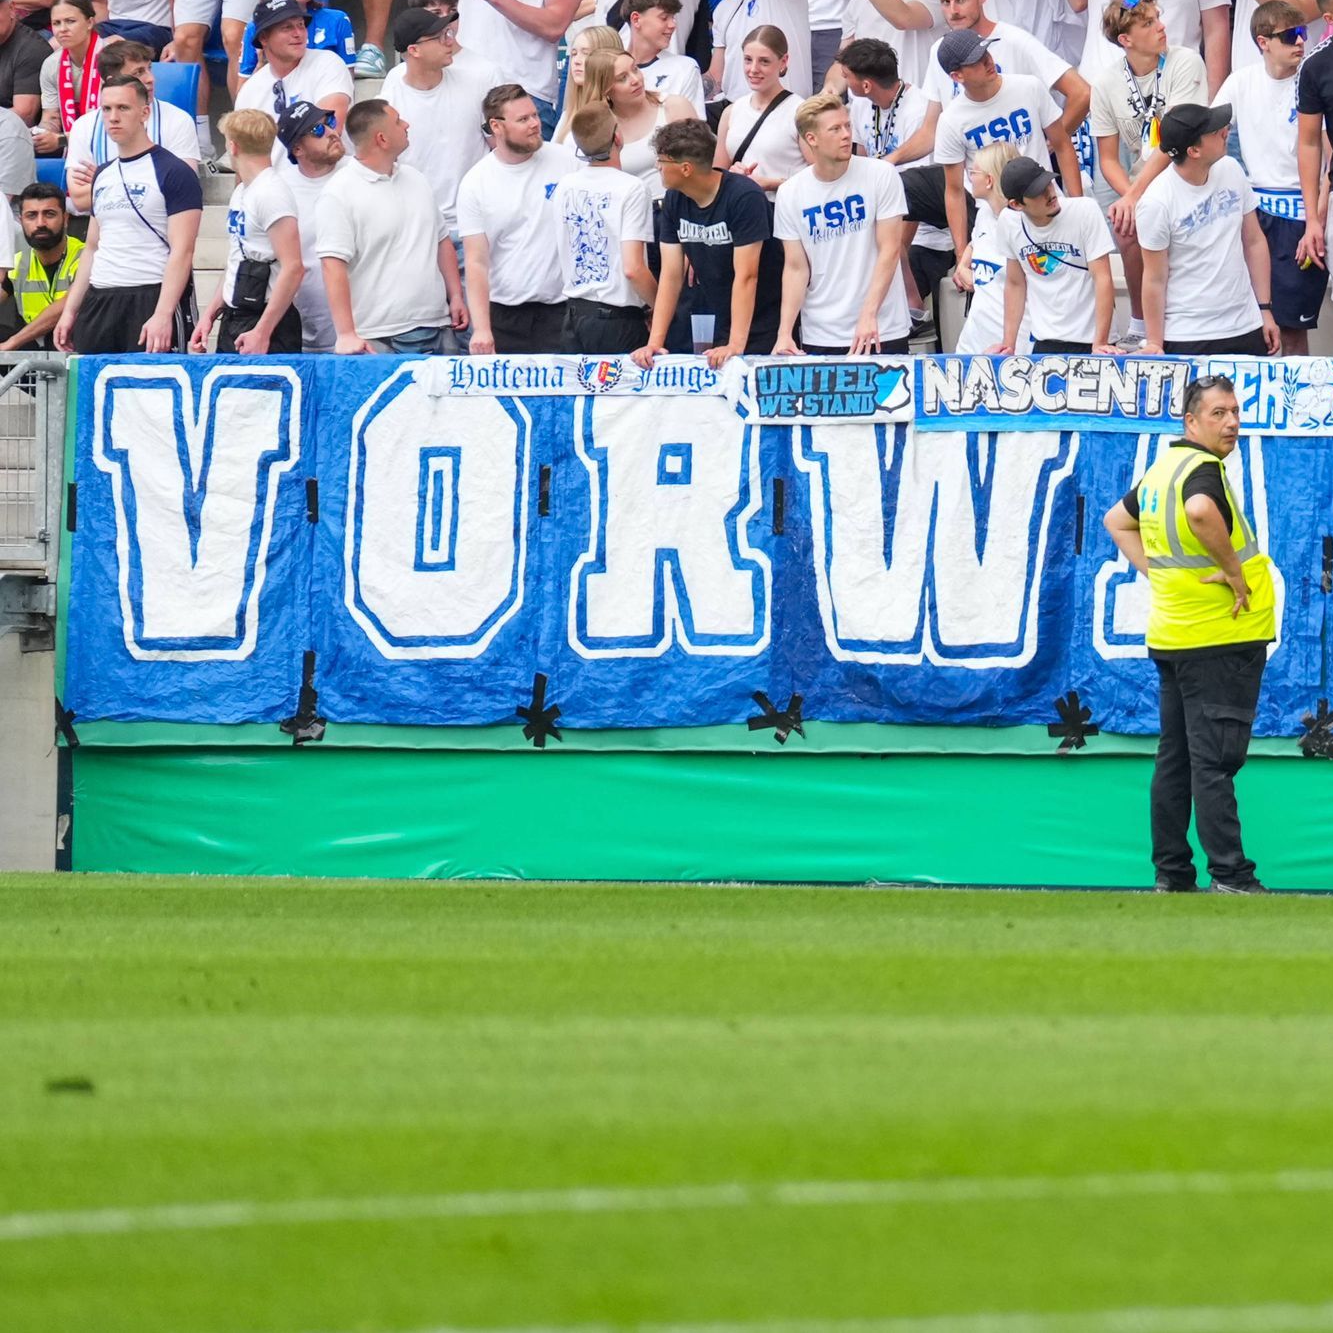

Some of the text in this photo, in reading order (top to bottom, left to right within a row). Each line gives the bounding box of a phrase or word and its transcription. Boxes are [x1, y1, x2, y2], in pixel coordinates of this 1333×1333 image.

[965, 107, 1032, 150] TSG
[802, 193, 867, 237] TSG
[448, 358, 565, 395] Hoffema
[757, 365, 876, 395] UNITED
[922, 356, 1191, 416] NASCENTI
[758, 393, 876, 417] WE STAND
